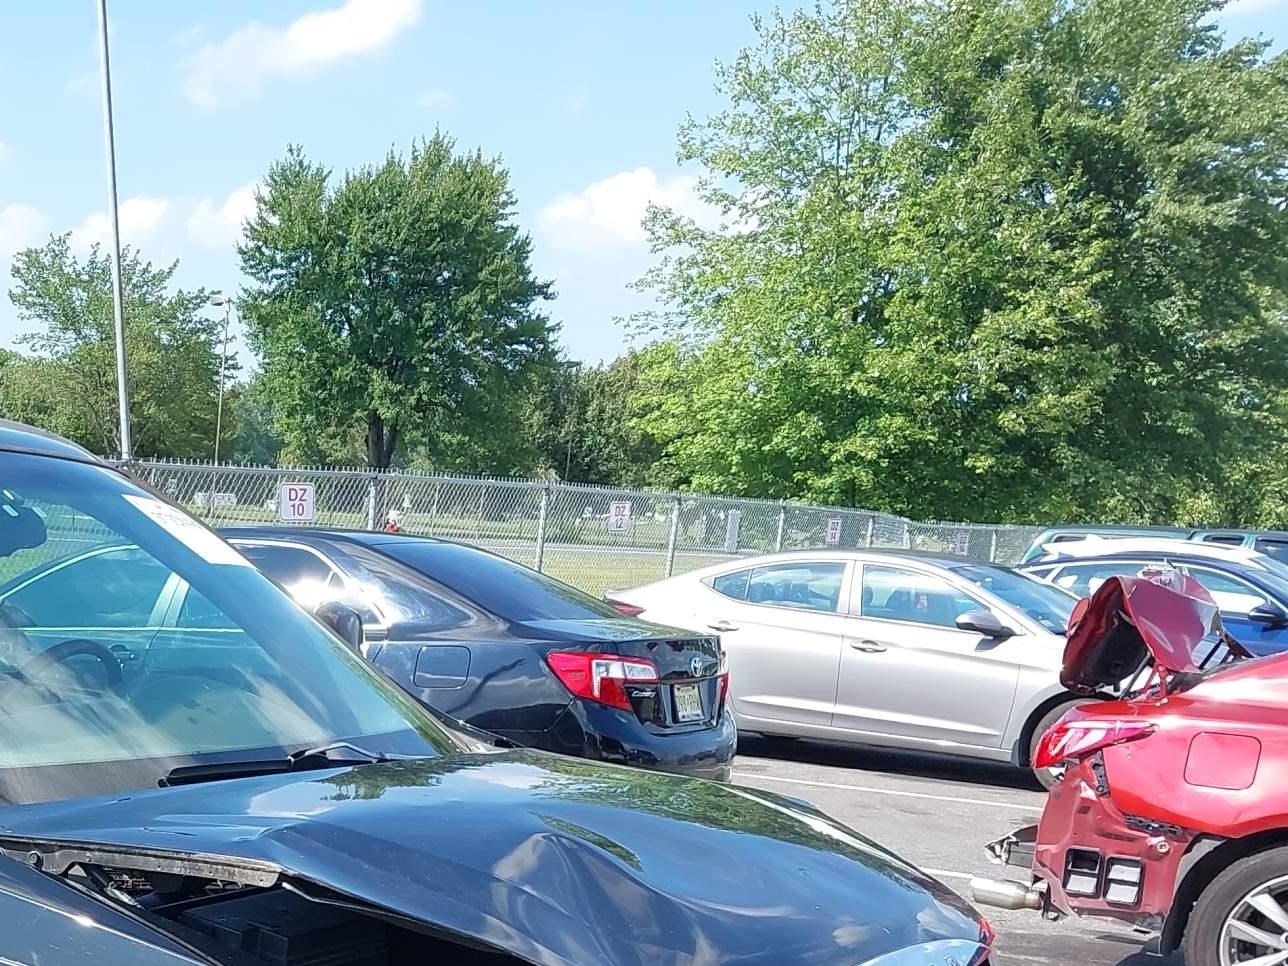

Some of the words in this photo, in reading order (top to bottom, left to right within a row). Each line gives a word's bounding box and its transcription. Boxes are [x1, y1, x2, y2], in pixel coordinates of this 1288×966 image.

[288, 487, 308, 502] DZ
[290, 503, 305, 517] 10
[614, 505, 627, 517] DZ
[615, 517, 624, 529] 12
